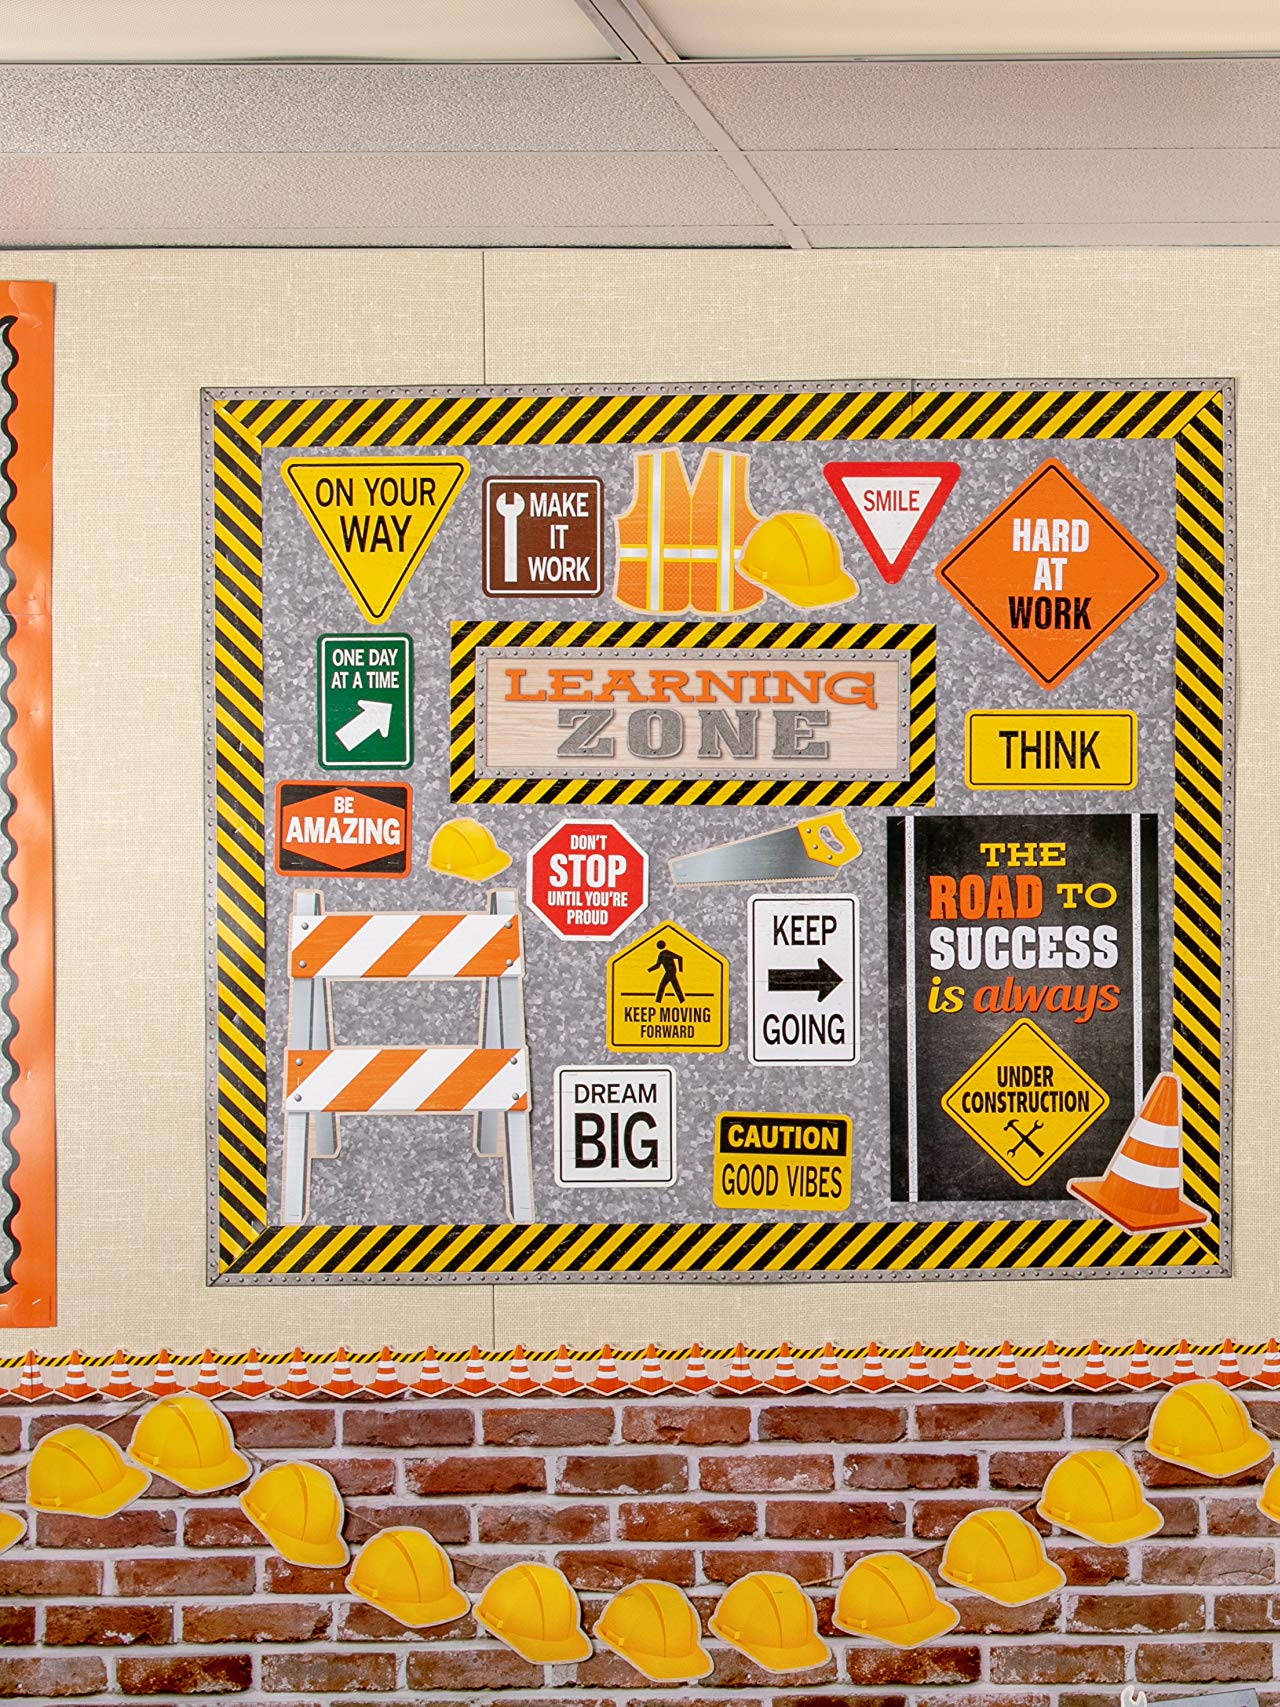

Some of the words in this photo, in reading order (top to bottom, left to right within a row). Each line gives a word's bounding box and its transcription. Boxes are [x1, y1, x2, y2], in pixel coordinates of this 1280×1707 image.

[316, 478, 353, 507] ON
[364, 477, 435, 506] YOUR
[530, 493, 588, 517] MAKE
[864, 490, 919, 511] SMILE
[340, 515, 412, 552] WAY
[551, 525, 568, 549] IT
[1013, 518, 1089, 552] HARD
[528, 557, 590, 581] WORK
[1033, 558, 1067, 590] AT
[1009, 596, 1091, 629] WORK
[333, 649, 364, 666] ONE
[369, 649, 398, 665] DAY
[332, 672, 349, 688] AT
[353, 672, 362, 688] A
[367, 672, 399, 688] TIME
[505, 668, 876, 710] LEARNING
[557, 709, 828, 759] ZONE
[999, 731, 1100, 769] THINK
[334, 797, 354, 813] BE
[286, 817, 400, 845] AMAZING
[571, 835, 607, 850] DON'T
[980, 843, 1065, 866] THE
[550, 854, 626, 887] STOP
[548, 891, 583, 906] UNTIL
[585, 891, 628, 906] YOU'RE
[930, 875, 1042, 919] ROAD
[1057, 883, 1117, 908] TO
[567, 910, 608, 925] PROUD
[774, 915, 836, 945] KEEP
[930, 925, 1118, 970] SUCCESS
[929, 976, 964, 1012] is
[974, 977, 1120, 1023] always
[625, 1007, 656, 1022] KEEP
[660, 1007, 710, 1022] MOVING
[641, 1025, 694, 1038] FORWARD
[763, 1014, 844, 1045] GOING
[998, 1066, 1053, 1087] UNDER
[575, 1084, 656, 1103] DREAM
[962, 1091, 1089, 1113] CONSTRUCTION
[575, 1112, 658, 1169] BIG
[728, 1124, 838, 1150] CAUTION
[722, 1164, 778, 1196] GOOD
[787, 1166, 841, 1198] VIBES
